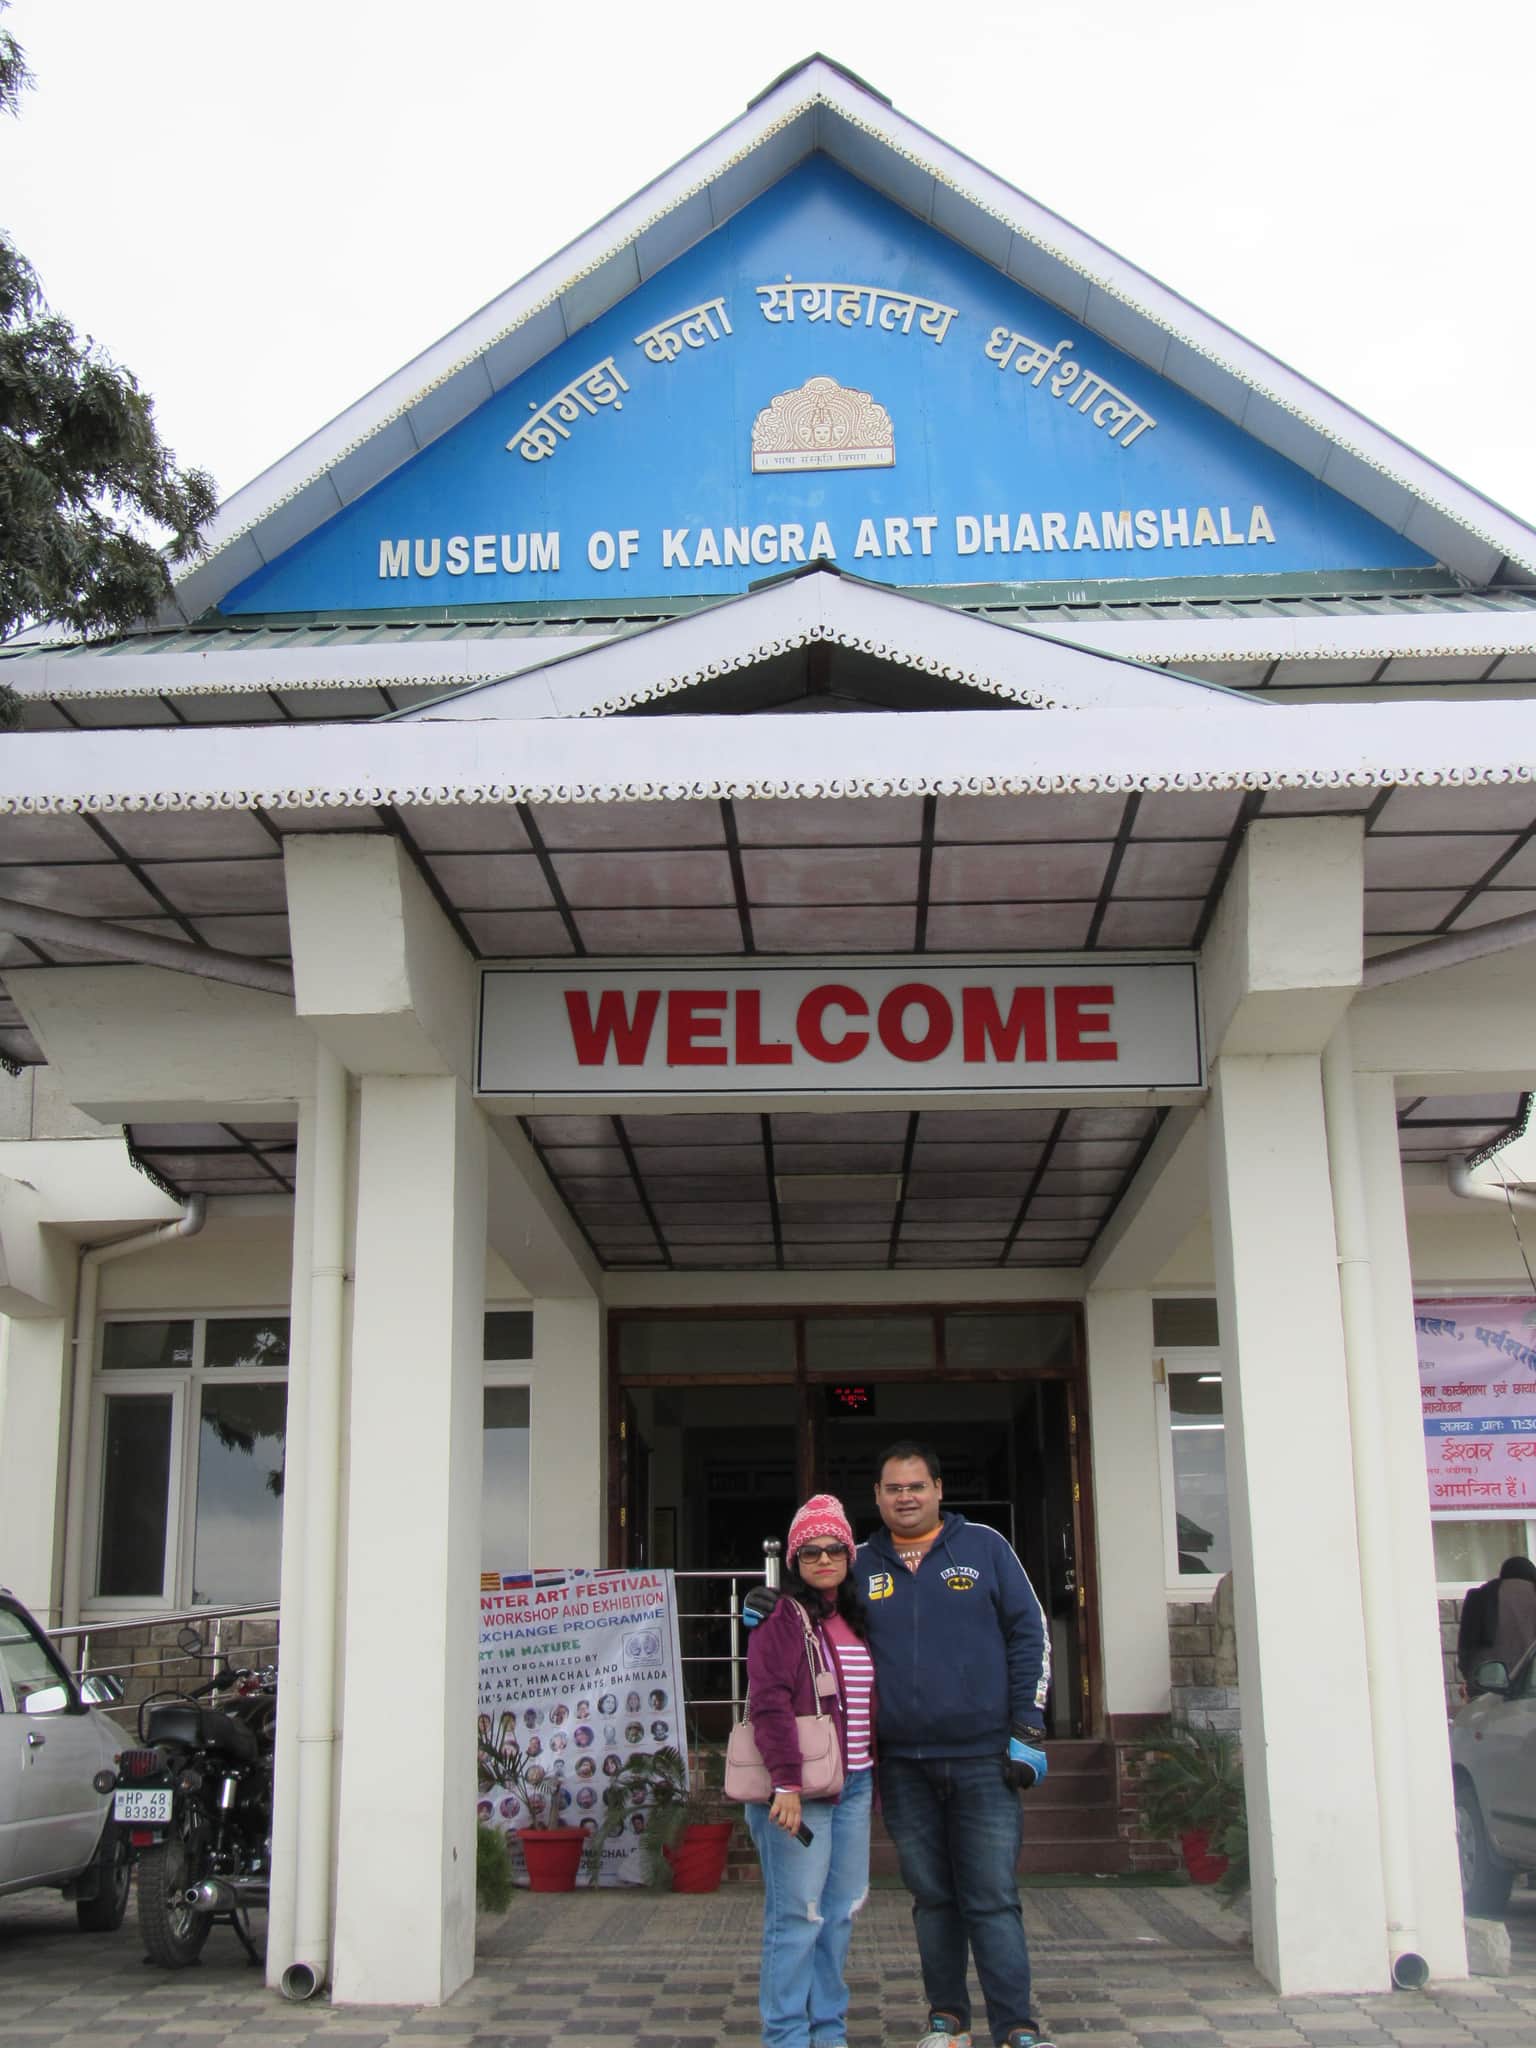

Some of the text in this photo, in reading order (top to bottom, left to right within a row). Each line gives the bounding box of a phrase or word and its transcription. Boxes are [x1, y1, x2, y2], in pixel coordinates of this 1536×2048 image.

[505, 273, 1158, 462] कांगड़ा कला संग्रहालय धर्मशाला
[378, 504, 1276, 578] MUSEUM OF KANGRA ART DHARAMSHALA
[563, 982, 1119, 1067] WELCOME
[941, 1567, 979, 1579] BATMAN
[535, 1588, 570, 1605] ART
[576, 1574, 663, 1599] FESTIVAL
[483, 1591, 664, 1627] WORKSHOP AND EXHIBITION
[479, 1608, 665, 1643] XCHANGE PROGRAMME
[499, 1647, 516, 1658] IN
[521, 1640, 582, 1657] NATURE
[512, 1656, 581, 1672] ORGANIZED
[585, 1654, 599, 1663] BY
[506, 1686, 558, 1701] ACADEMY
[561, 1683, 576, 1695] OF
[610, 1670, 668, 1686] BHAMLADA
[527, 1670, 590, 1686] HIMACHAL
[594, 1664, 618, 1676] AND
[125, 1806, 166, 1819] B3382
[126, 1791, 167, 1806] HP 48
